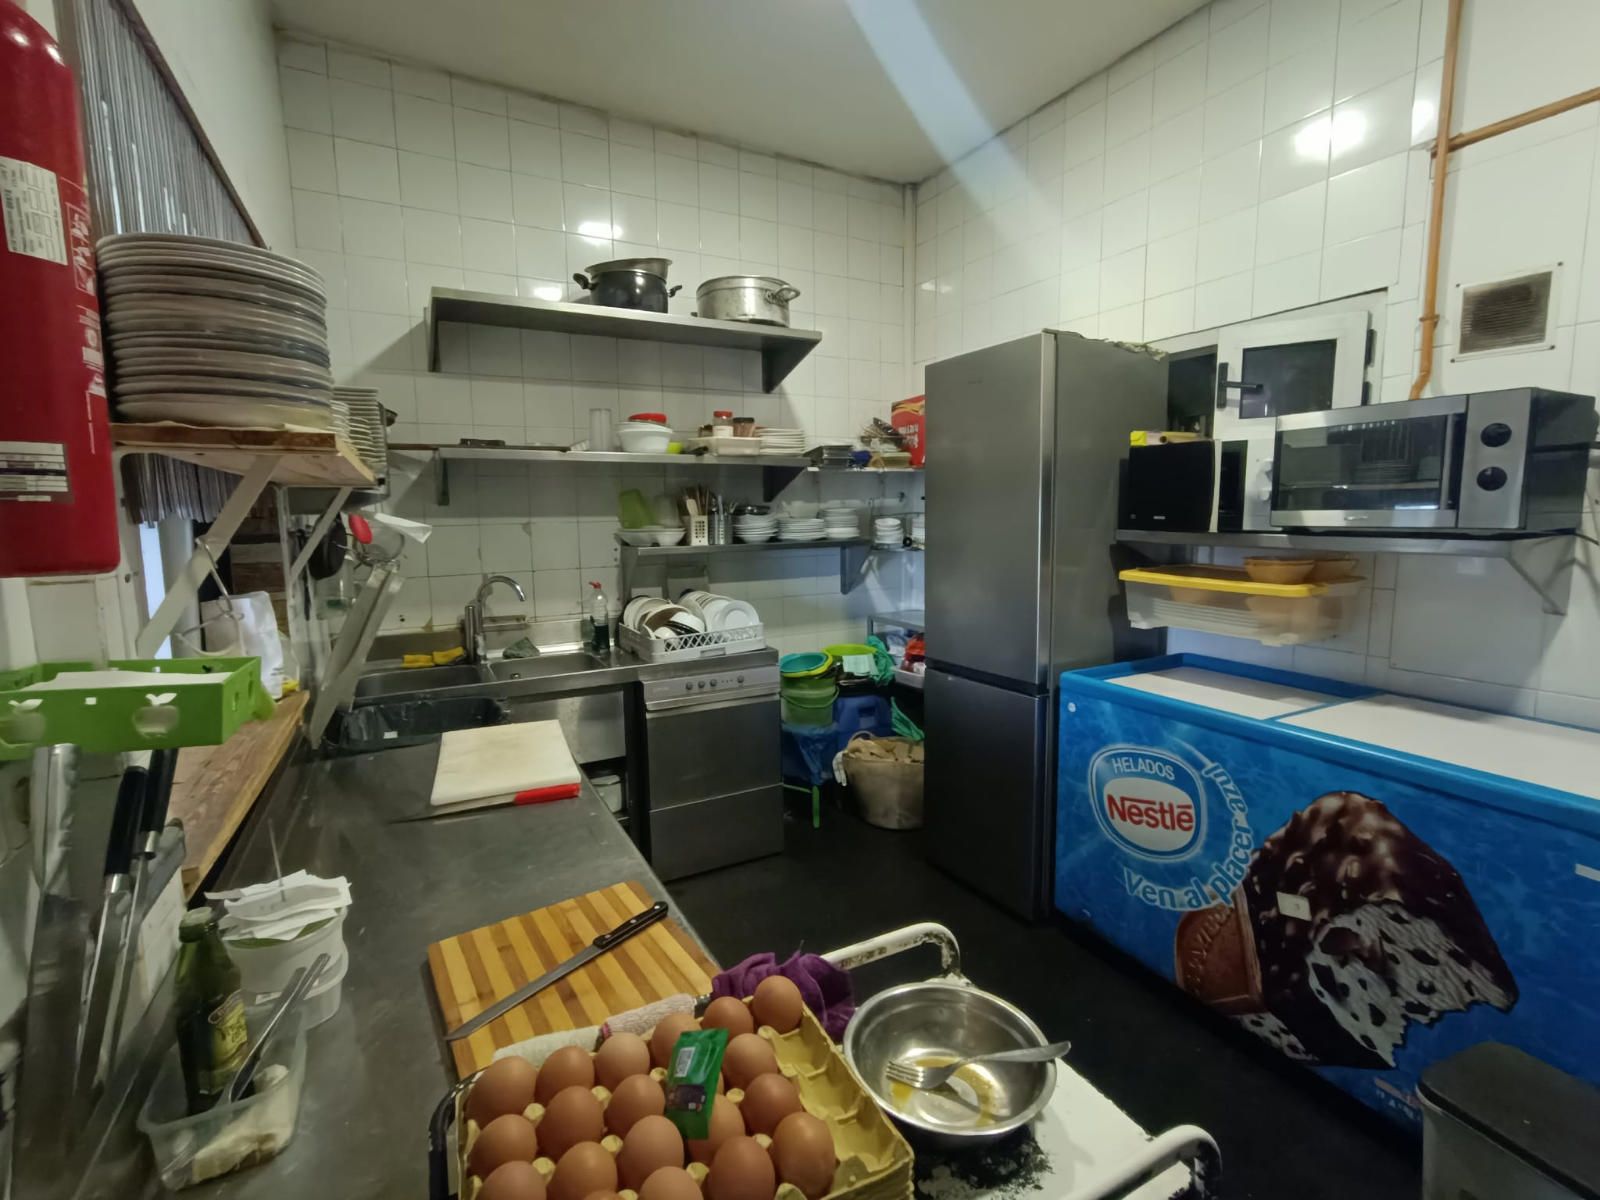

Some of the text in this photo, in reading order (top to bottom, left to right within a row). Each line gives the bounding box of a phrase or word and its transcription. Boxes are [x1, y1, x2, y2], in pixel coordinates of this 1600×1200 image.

[1112, 757, 1175, 780] HELADOS
[1107, 794, 1193, 831] Nestlé
[1123, 866, 1177, 910] Ven
[1183, 877, 1214, 910] al
[1208, 818, 1253, 908] placer
